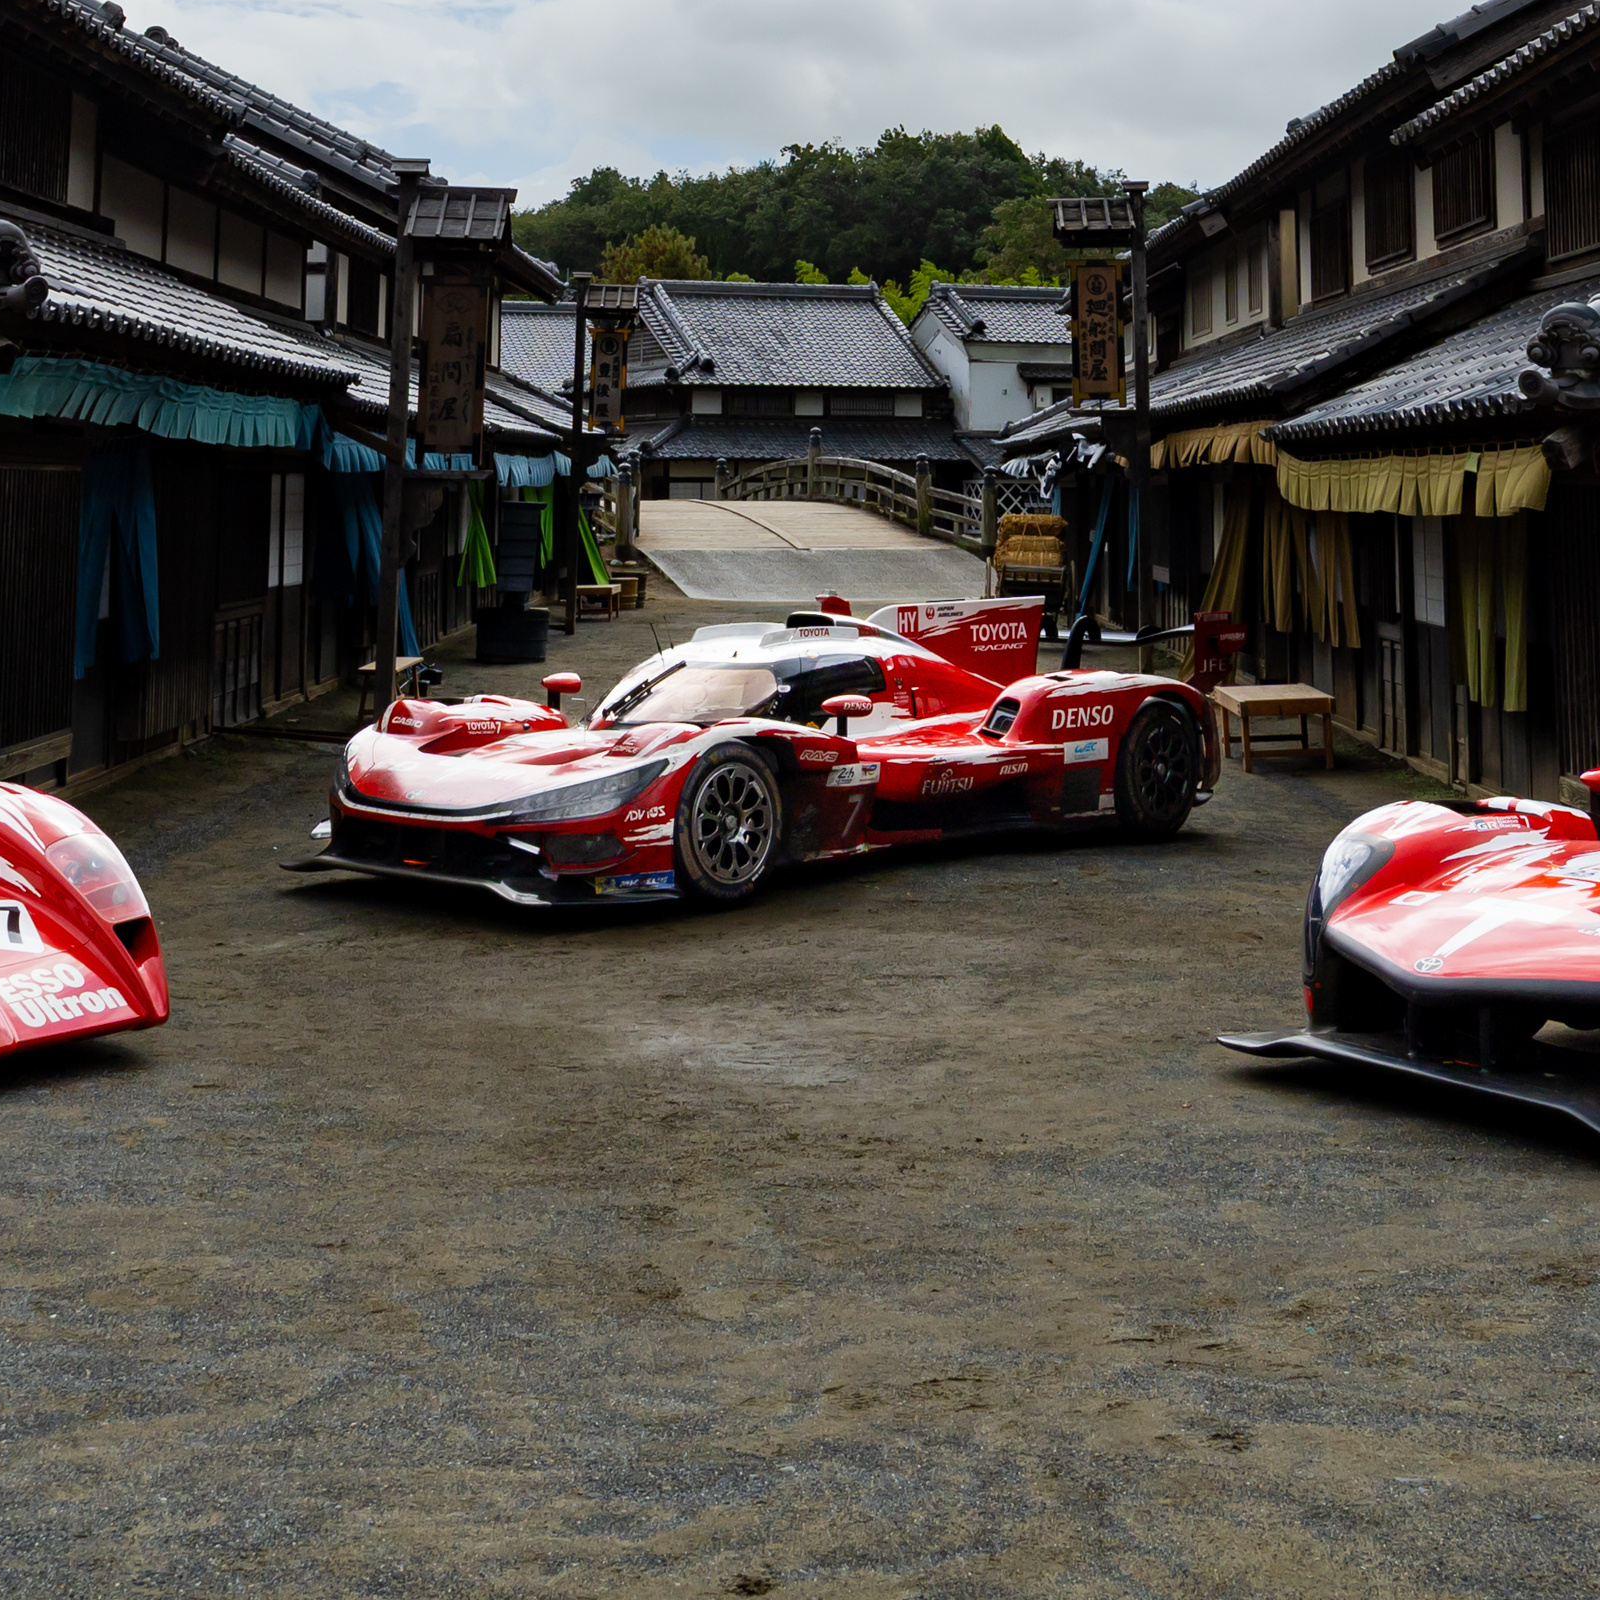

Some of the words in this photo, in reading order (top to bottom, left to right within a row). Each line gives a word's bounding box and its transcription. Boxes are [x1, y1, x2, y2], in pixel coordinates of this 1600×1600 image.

[438, 321, 463, 421] 扇問屋
[899, 611, 917, 634] HY
[798, 628, 830, 638] TOYOTA
[970, 622, 1027, 642] TOYOTA
[971, 642, 1027, 652] RACING
[843, 702, 872, 711] DENSO
[391, 716, 424, 728] CASIO
[1052, 705, 1114, 730] DENSO
[465, 721, 496, 730] TOYOTA
[495, 721, 502, 734] 7
[800, 749, 838, 763] RAYS
[1000, 762, 1029, 775] AISIN
[921, 776, 974, 796] FUJITSU
[7, 985, 129, 1028] Ultron
